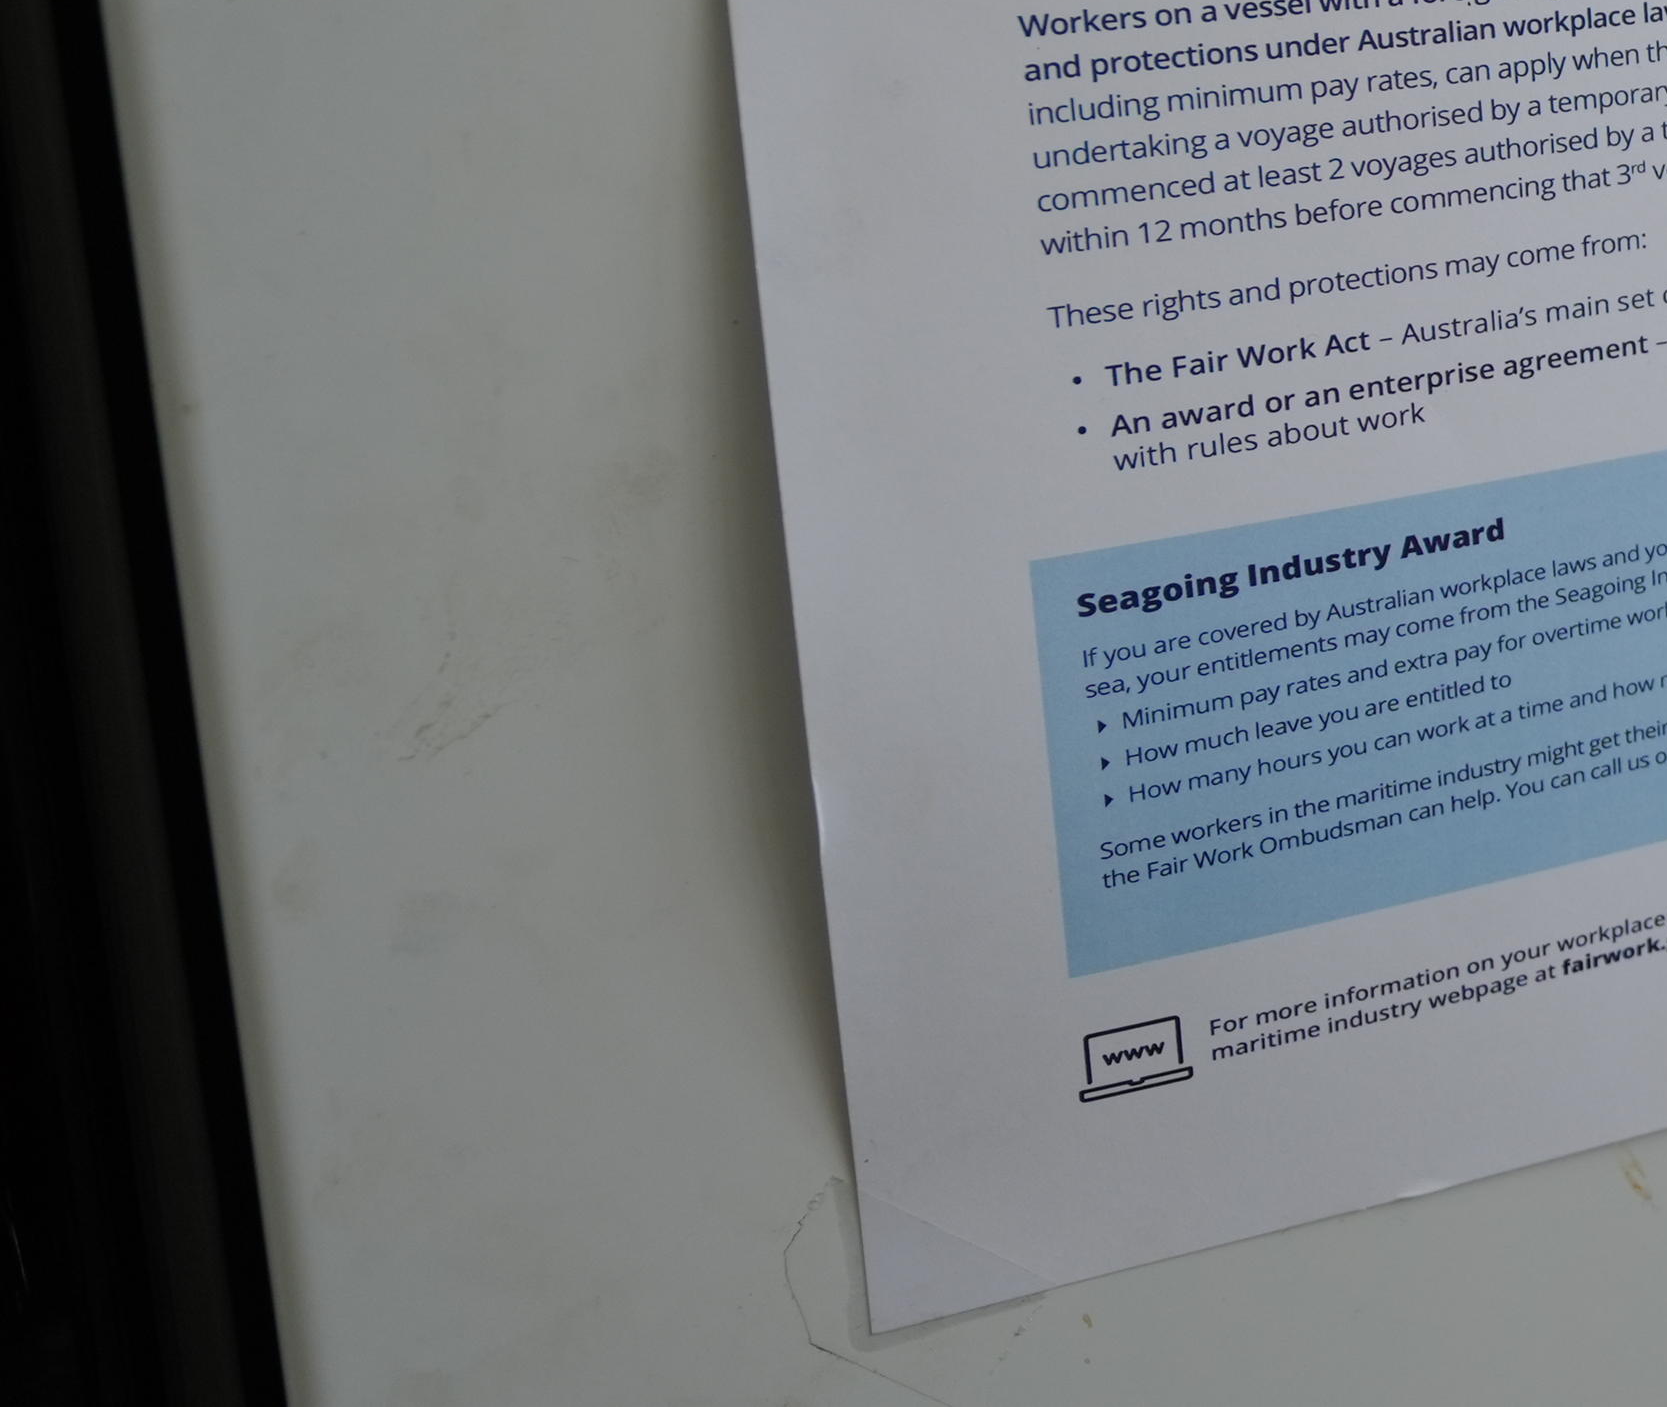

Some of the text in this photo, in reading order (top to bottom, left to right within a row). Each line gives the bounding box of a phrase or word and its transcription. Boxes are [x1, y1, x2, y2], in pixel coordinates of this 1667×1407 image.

[1017, 9, 1147, 38] Workers
[1155, 7, 1191, 27] on
[1201, 5, 1217, 23] a
[1025, 53, 1080, 82] and
[1091, 43, 1258, 83] protections
[1266, 32, 1350, 60] under
[1358, 19, 1495, 51] Australian
[1503, 7, 1635, 37] workplace
[1105, 361, 1161, 387] The
[1173, 351, 1228, 378] Fair
[1237, 337, 1316, 369] Work
[1325, 332, 1370, 357] Act
[1402, 306, 1537, 345] Australia’s
[1546, 296, 1609, 323] main
[1618, 289, 1654, 312] set
[1077, 516, 1504, 618] Seagoing Industry Award
[1123, 695, 1233, 729] Minimum
[1241, 685, 1280, 711] pay
[1287, 673, 1341, 696] rates
[1348, 659, 1387, 684] and
[1395, 651, 1447, 674] extra
[1455, 642, 1491, 667] pay
[1498, 634, 1526, 653] for
[1533, 616, 1621, 646] overtime
[1126, 674, 1511, 766] How much leave you are entitled to
[1210, 1015, 1248, 1036] For
[1256, 1000, 1317, 1026] more
[1325, 966, 1459, 1009] information
[1467, 957, 1494, 975] on
[1501, 942, 1550, 971] your
[1557, 914, 1665, 952] workplace
[1212, 1024, 1320, 1061] maritime
[1328, 999, 1421, 1034] industry
[1429, 974, 1527, 1009] webpage
[1535, 965, 1555, 983] at
[1101, 1041, 1166, 1068] www
